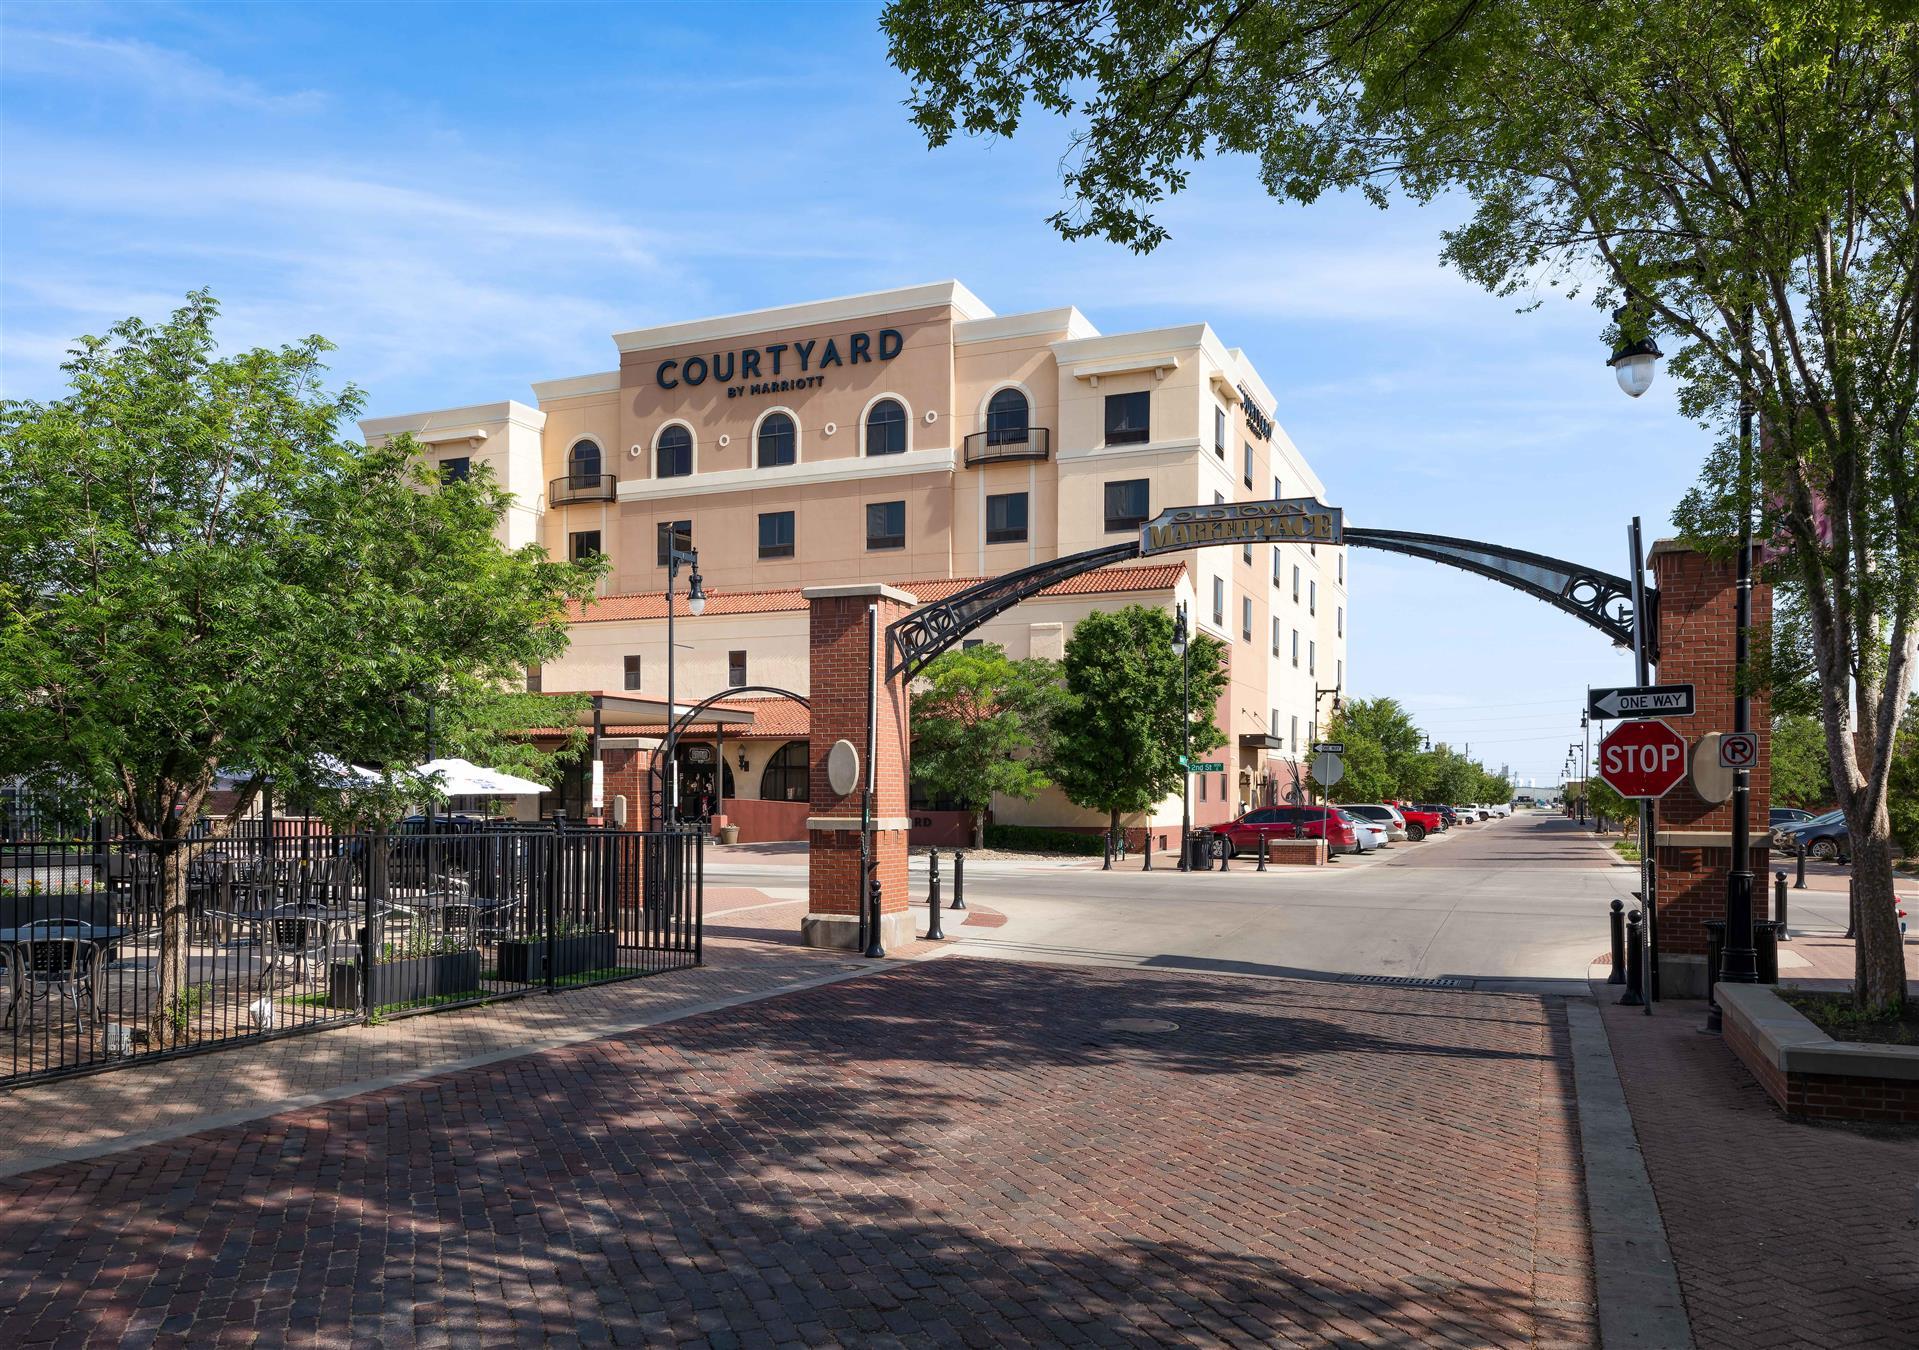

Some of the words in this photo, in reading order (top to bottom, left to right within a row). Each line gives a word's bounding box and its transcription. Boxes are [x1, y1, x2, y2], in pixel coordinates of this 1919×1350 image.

[656, 328, 904, 390] COURTYARD
[727, 385, 744, 399] BY
[750, 375, 825, 396] MARRIOTT
[1173, 506, 1228, 522] OLD
[1233, 502, 1306, 518] TOWN
[1149, 512, 1333, 549] MARKETPLACE
[1620, 695, 1648, 709] ONE
[1653, 693, 1683, 708] WAY
[1191, 763, 1204, 771] 2nd
[1204, 763, 1212, 771] St
[1605, 744, 1680, 774] STOP
